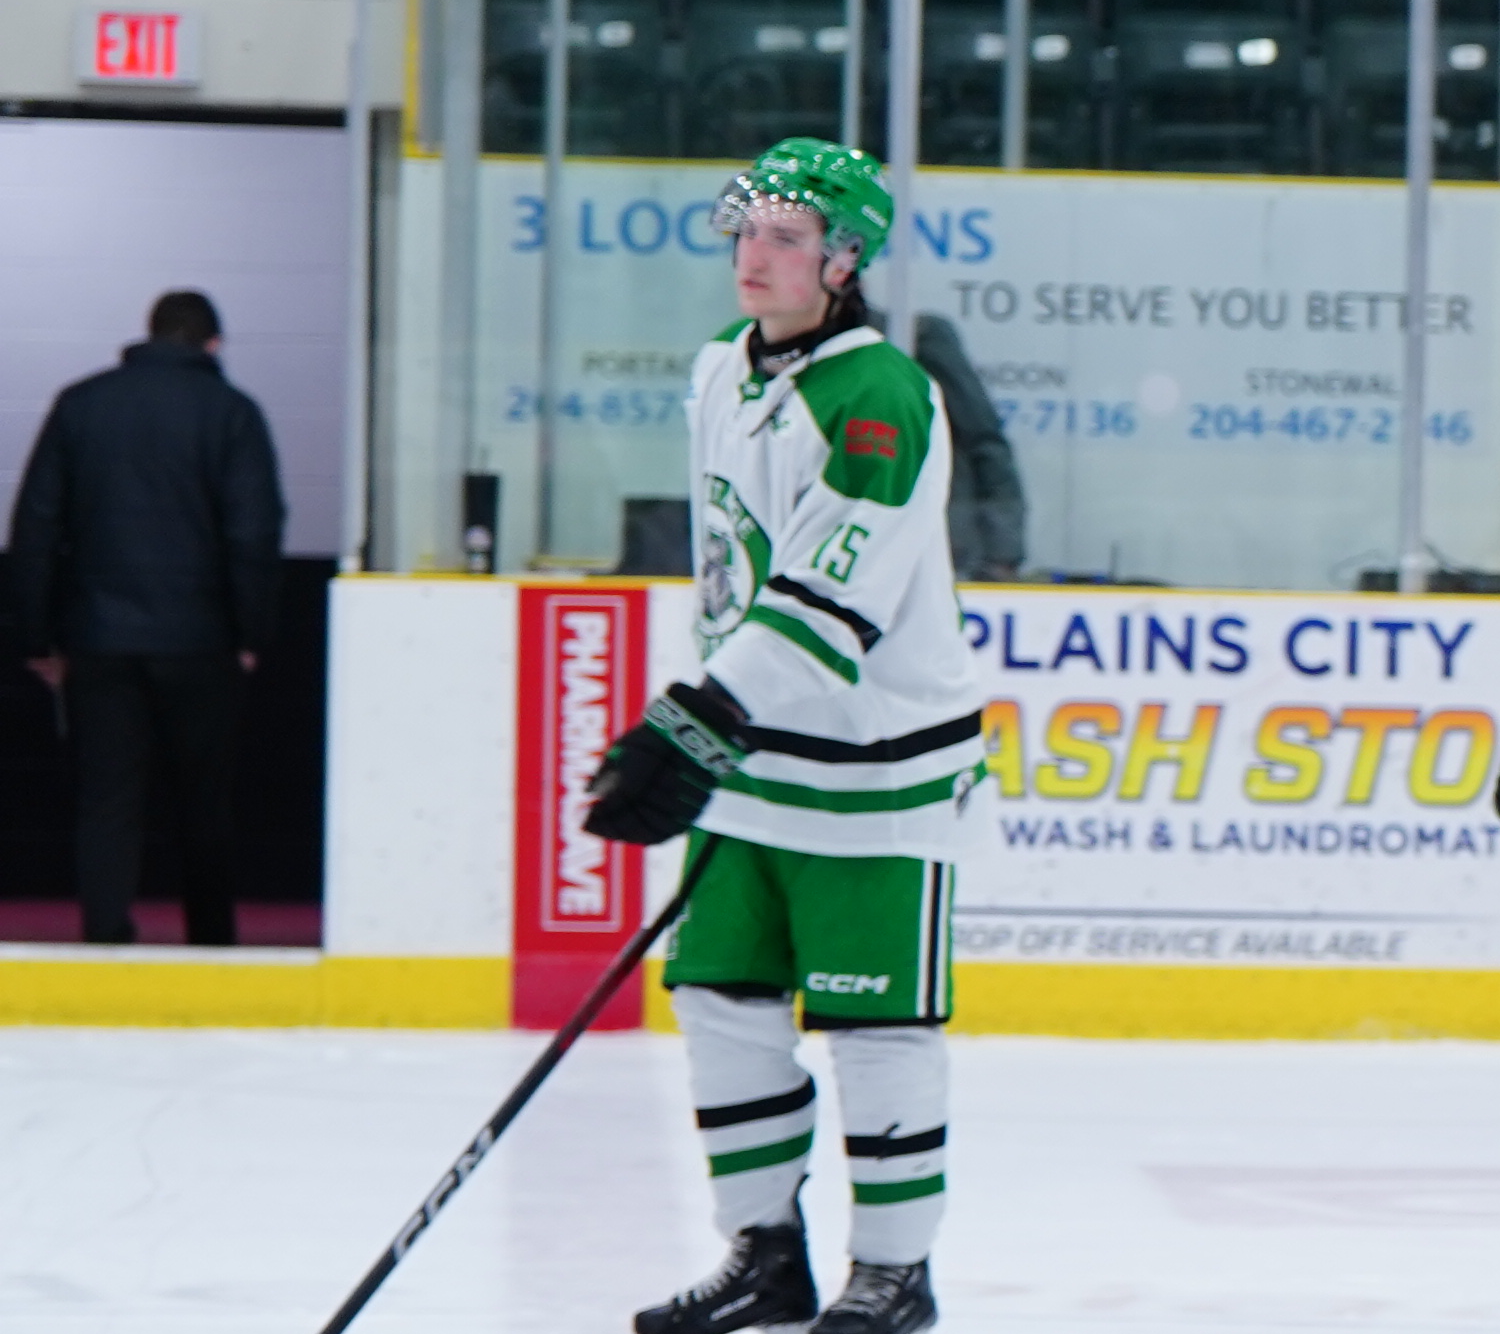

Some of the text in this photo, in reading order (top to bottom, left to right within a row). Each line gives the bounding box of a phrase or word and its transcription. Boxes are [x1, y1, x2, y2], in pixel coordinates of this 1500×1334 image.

[96, 12, 178, 79] EXIT
[514, 196, 998, 265] 3 LOCNS
[951, 280, 1018, 324] TO
[1034, 283, 1174, 327] SERVE
[1188, 287, 1288, 331] YOU
[1245, 368, 1401, 400] STONEWAL
[1188, 404, 1473, 446] 204-467-246
[962, 611, 1475, 679] PLAINS CITY
[981, 699, 1498, 808] ASH STO
[1002, 816, 1500, 858] WASH & LAUNDROMAT
[1016, 924, 1081, 958] OFF
[1085, 925, 1222, 961] SERVICE
[1230, 928, 1409, 964] AVAILABLE
[805, 971, 891, 996] CCM
